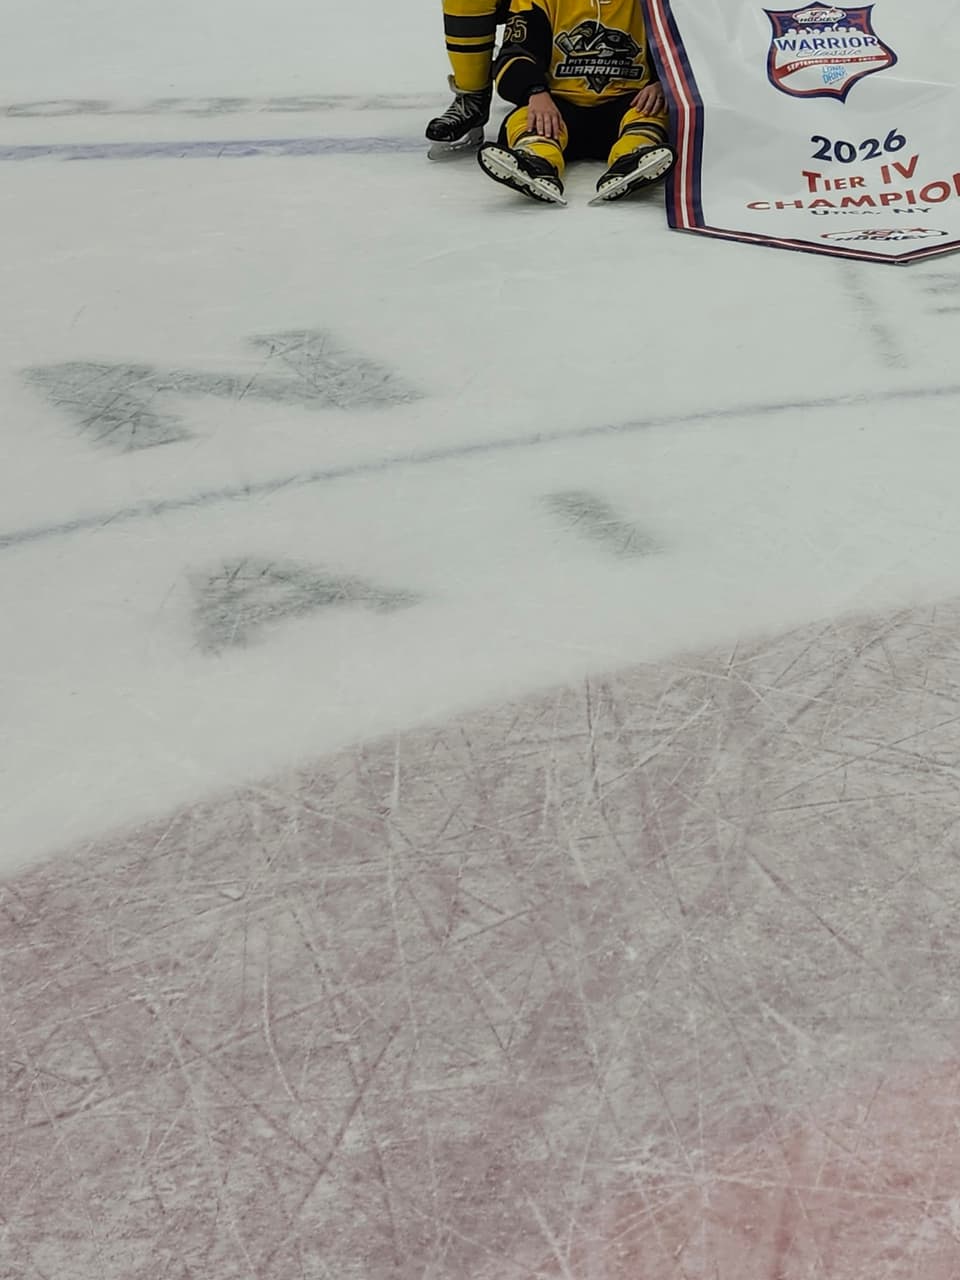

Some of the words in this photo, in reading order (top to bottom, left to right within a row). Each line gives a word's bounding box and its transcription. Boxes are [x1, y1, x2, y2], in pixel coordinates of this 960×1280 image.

[776, 35, 878, 51] WARRIOR
[810, 127, 907, 164] 2026
[880, 154, 920, 185] IV
[893, 206, 932, 214] NY
